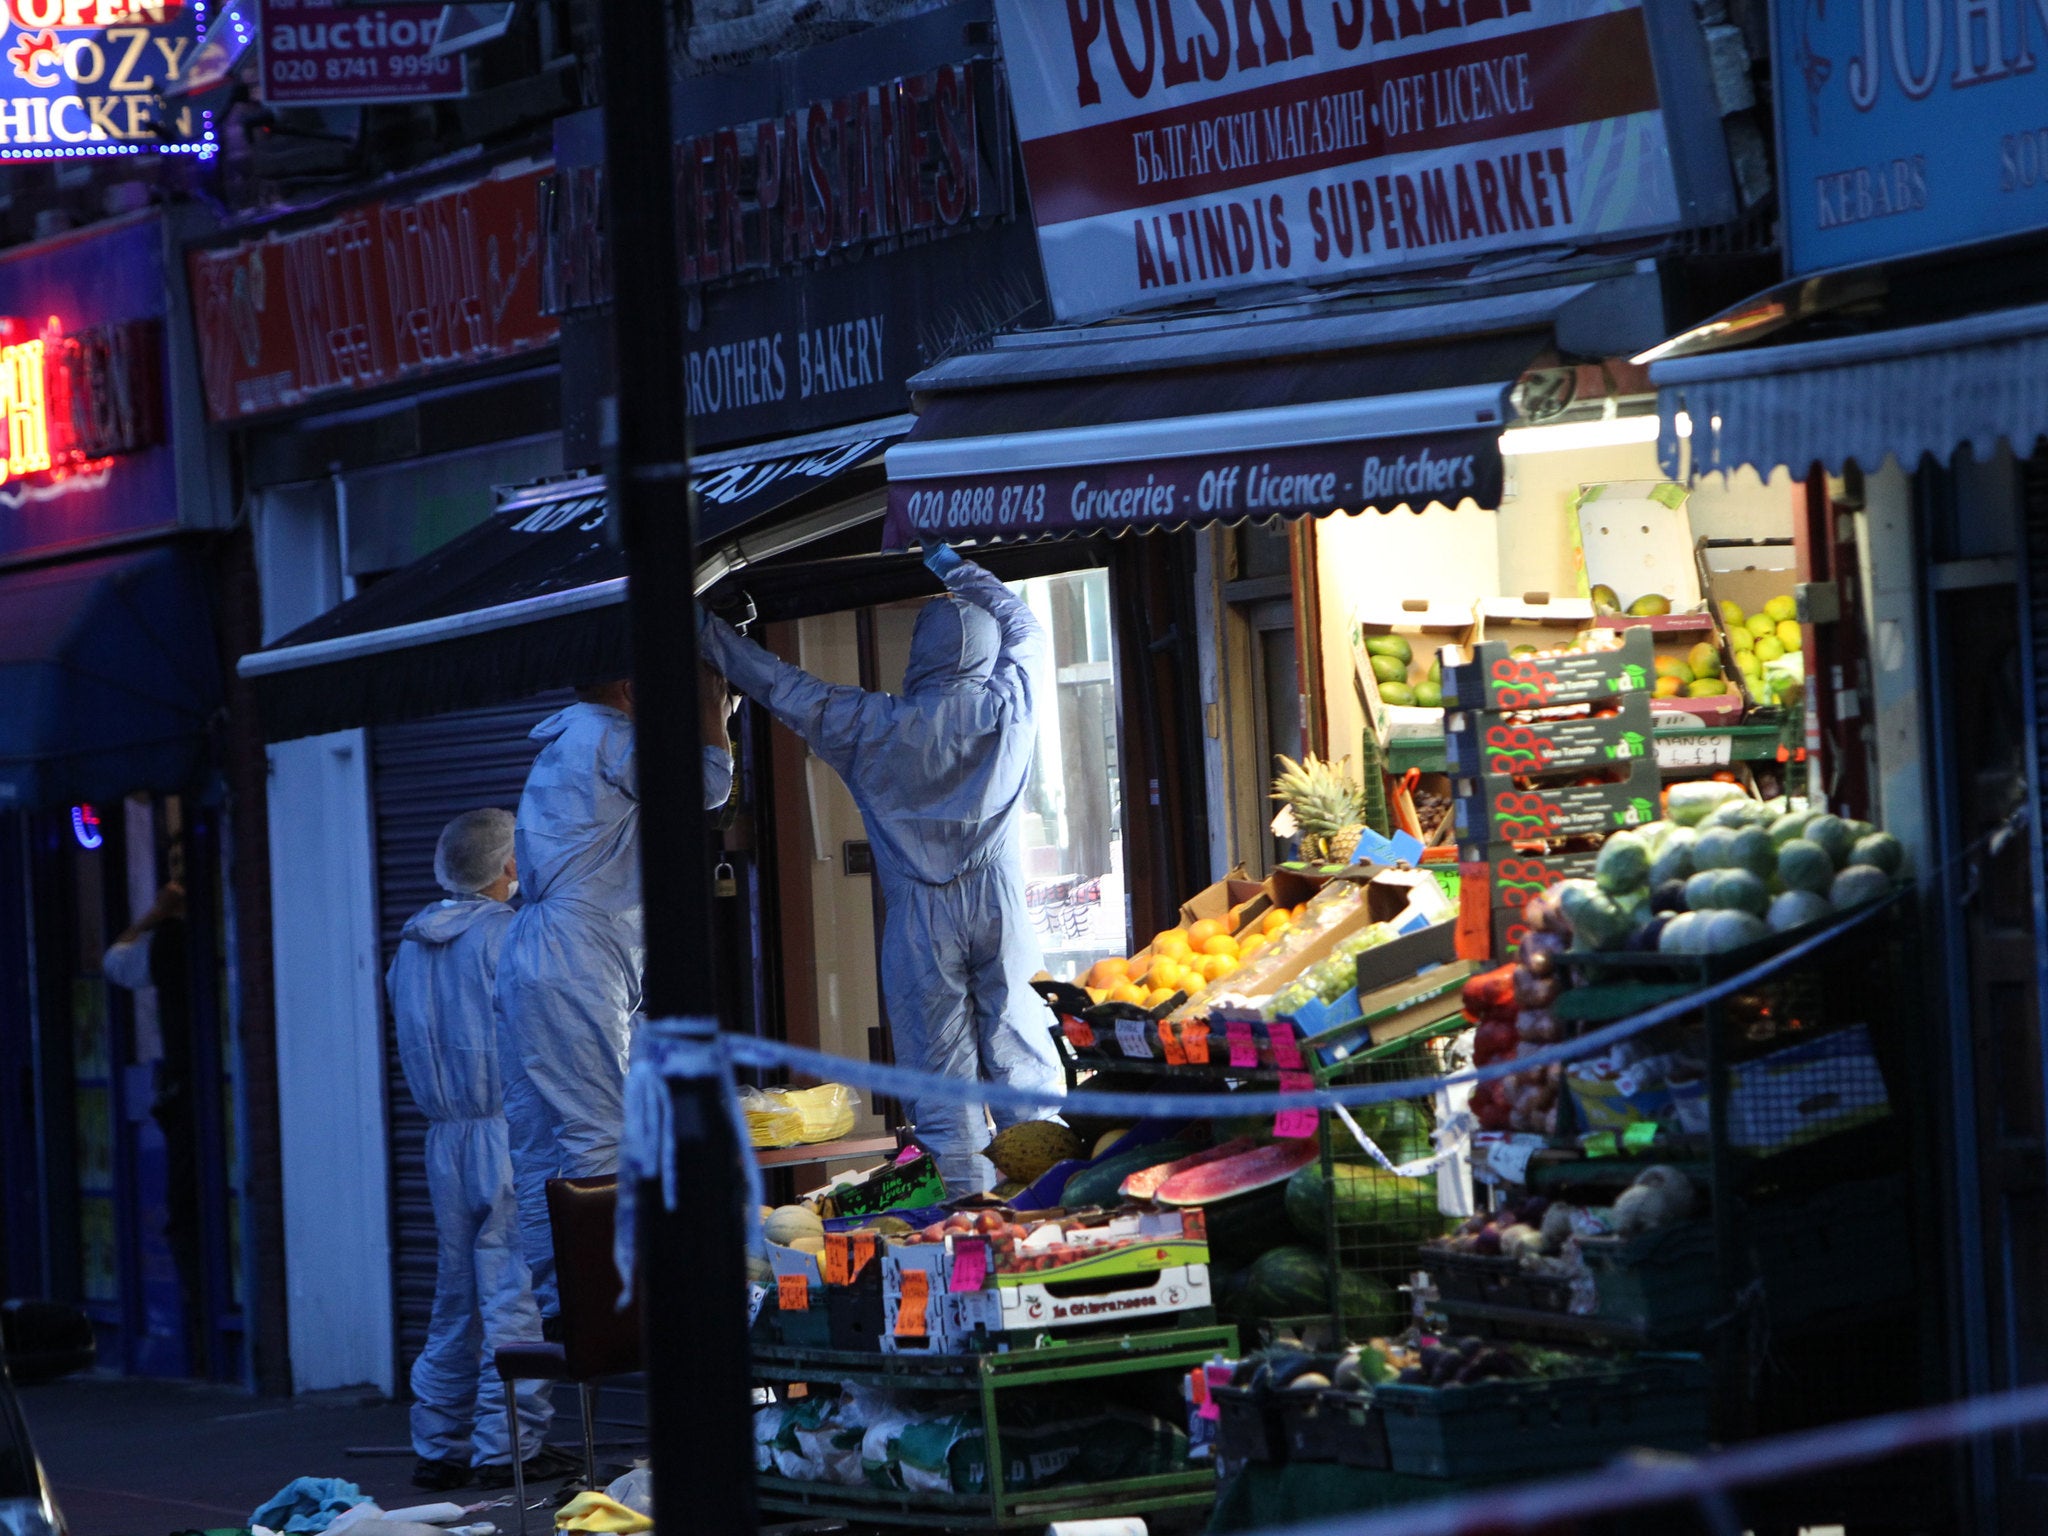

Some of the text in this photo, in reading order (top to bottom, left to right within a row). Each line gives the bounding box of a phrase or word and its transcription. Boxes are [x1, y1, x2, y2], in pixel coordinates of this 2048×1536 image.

[20, 28, 189, 92] COZY
[272, 58, 318, 82] 020
[325, 56, 379, 80] 8741
[1381, 52, 1534, 138] OFF LICENCE
[1132, 89, 1369, 186] БЪЛГАРСКИ МАГАЗИН
[1134, 146, 1573, 289] ALTINDIS SUPERMARKET
[1816, 154, 1928, 230] KEBABS
[798, 313, 885, 399] BAKERY
[907, 490, 944, 528] 020
[948, 485, 995, 528] 8888
[998, 483, 1046, 525] 8743
[1071, 473, 1176, 521] Groceries
[1198, 465, 1241, 512] Off
[1245, 463, 1337, 508] Licence
[1362, 447, 1475, 500] Butchers
